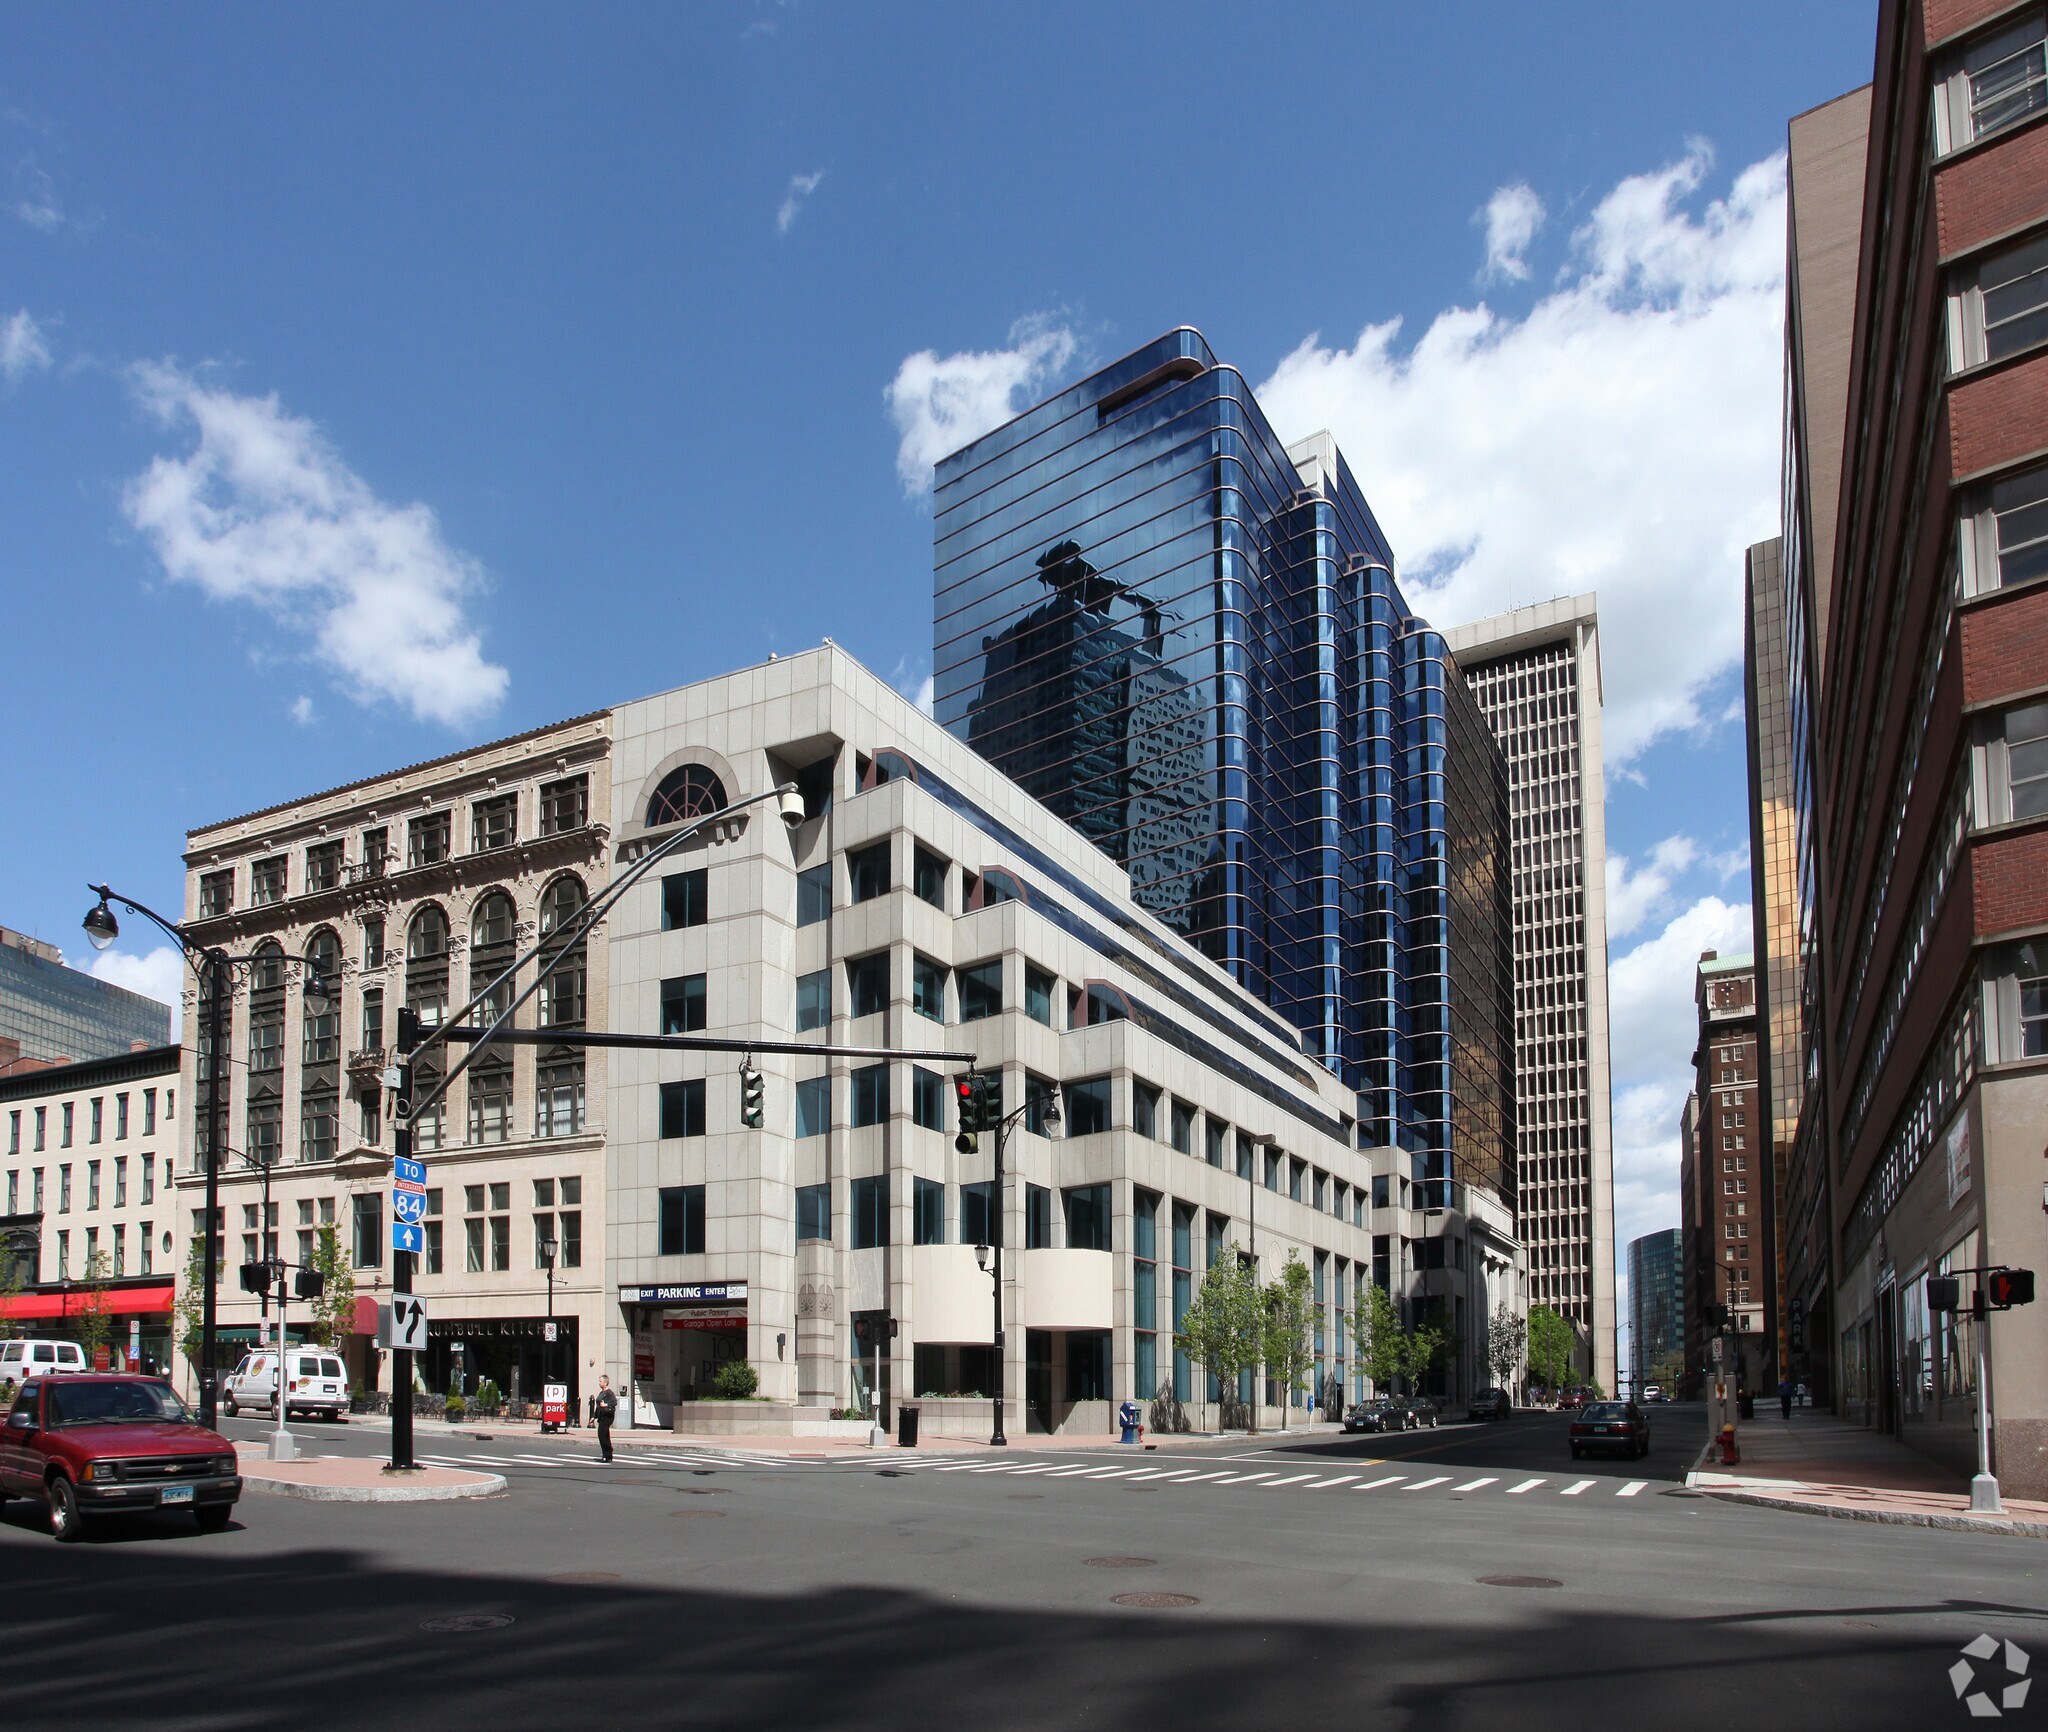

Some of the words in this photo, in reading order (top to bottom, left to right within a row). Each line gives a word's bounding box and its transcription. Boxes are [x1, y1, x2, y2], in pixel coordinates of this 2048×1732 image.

[403, 1163, 418, 1178] TO
[397, 1182, 422, 1192] INTERSTATE
[397, 1196, 421, 1217] 84
[640, 1289, 654, 1297] EXIT
[657, 1287, 701, 1298] PARKING
[705, 1287, 726, 1296] ENTER
[708, 1309, 730, 1317] Parking
[683, 1320, 705, 1328] Garage
[1792, 1300, 1802, 1345] PARK
[500, 1321, 570, 1336] KITCHN
[546, 1404, 565, 1413] park
